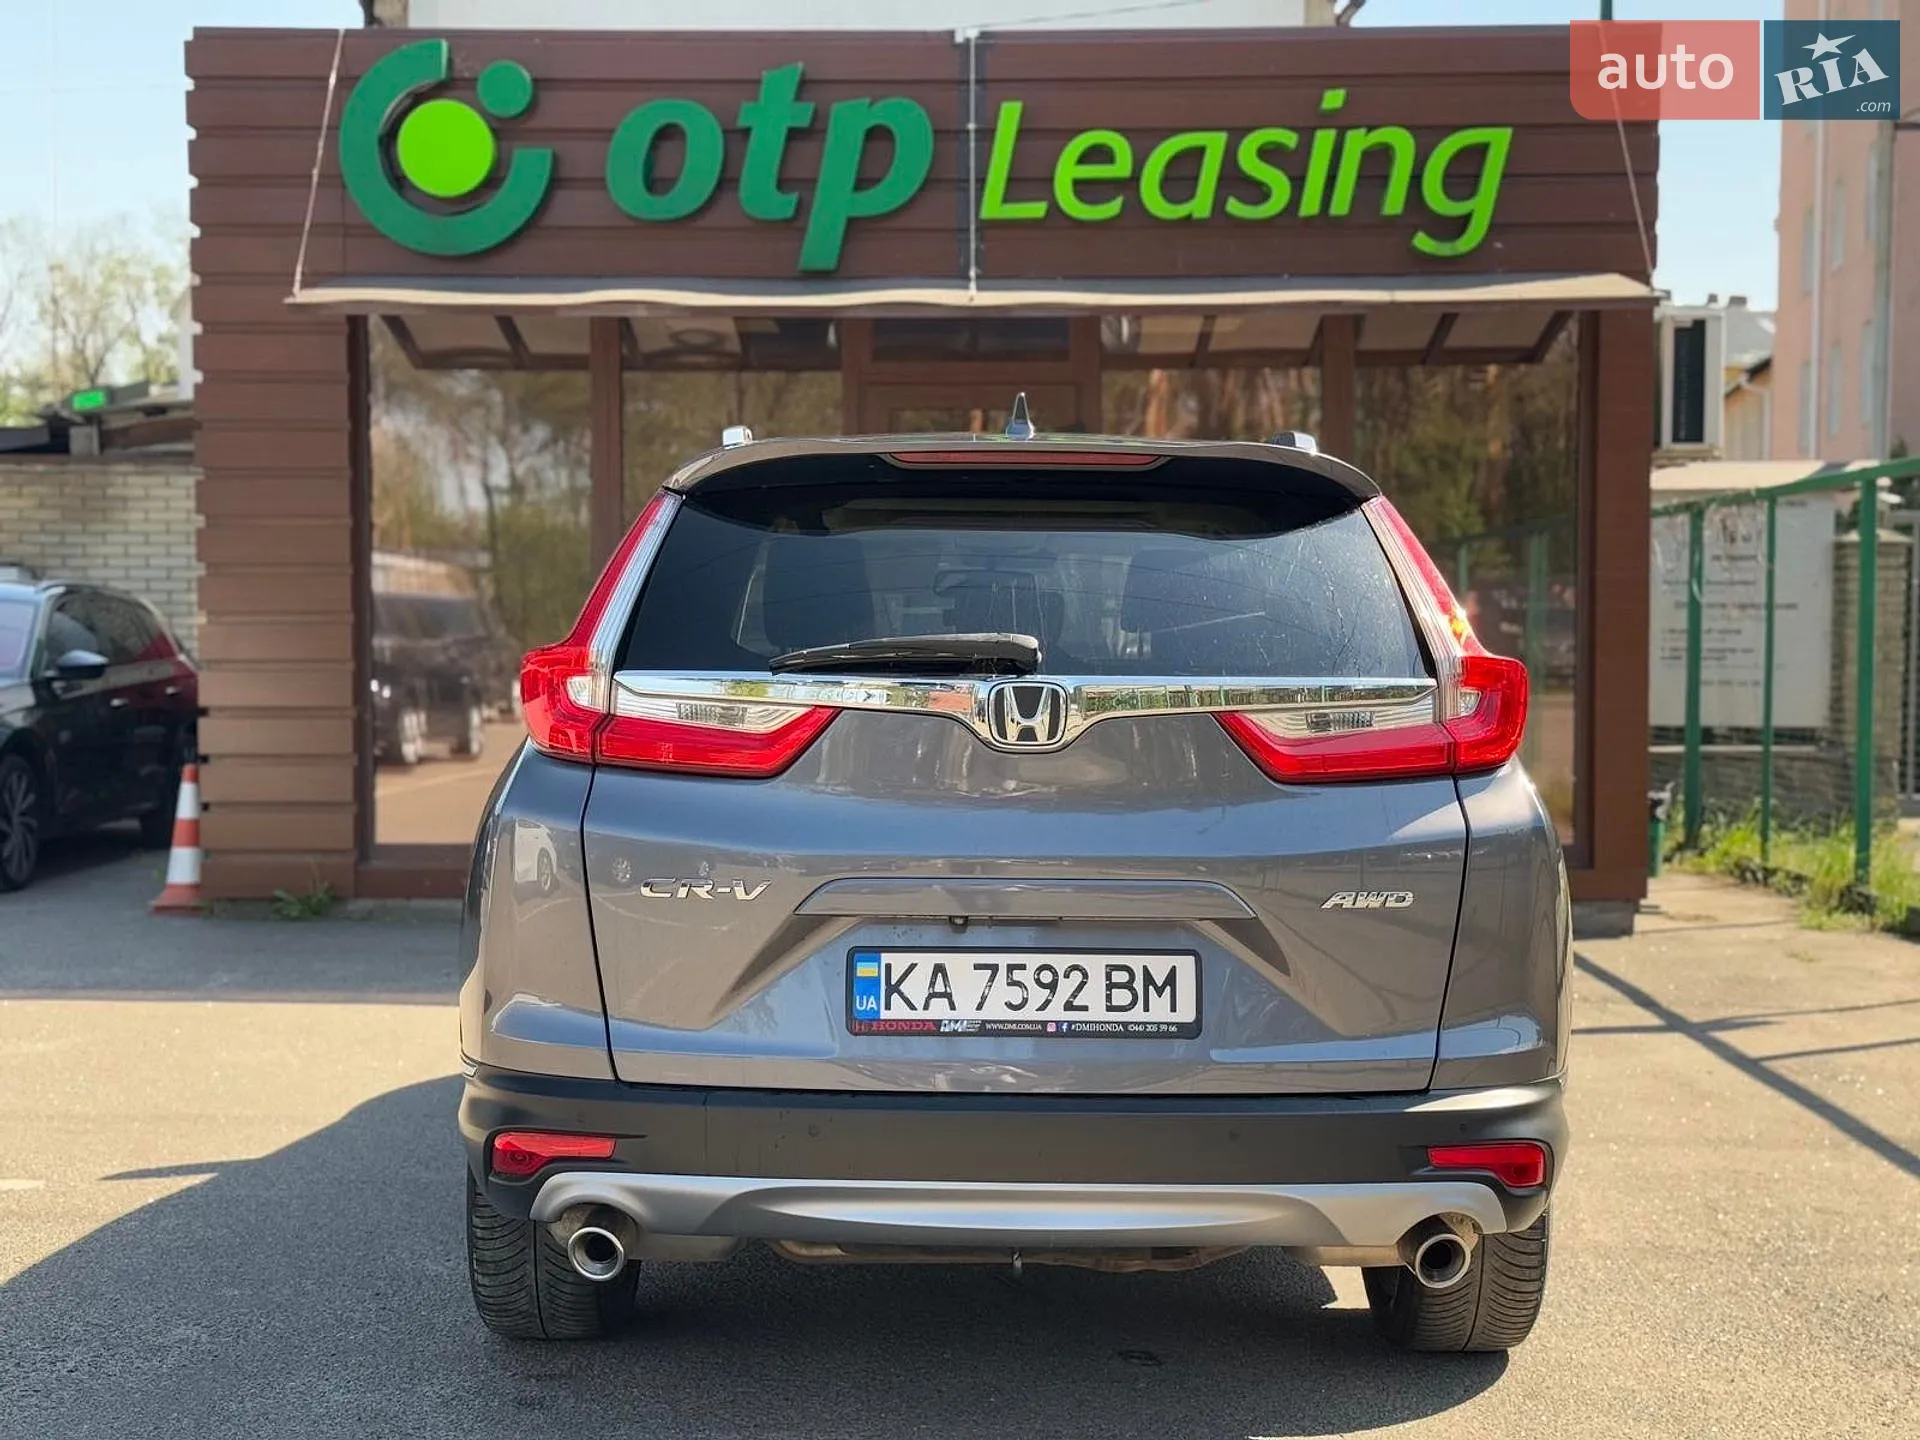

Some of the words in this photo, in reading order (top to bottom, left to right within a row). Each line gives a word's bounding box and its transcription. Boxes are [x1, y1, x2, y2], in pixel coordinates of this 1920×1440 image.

[606, 62, 934, 271] otp
[980, 89, 1513, 257] Leasing
[640, 876, 772, 901] CR-V
[1320, 891, 1414, 909] AWD
[884, 963, 957, 1011] KA
[973, 963, 1090, 1012] 7592
[1105, 964, 1178, 1013] BM
[856, 995, 877, 1011] UA
[871, 1020, 937, 1032] HONDA
